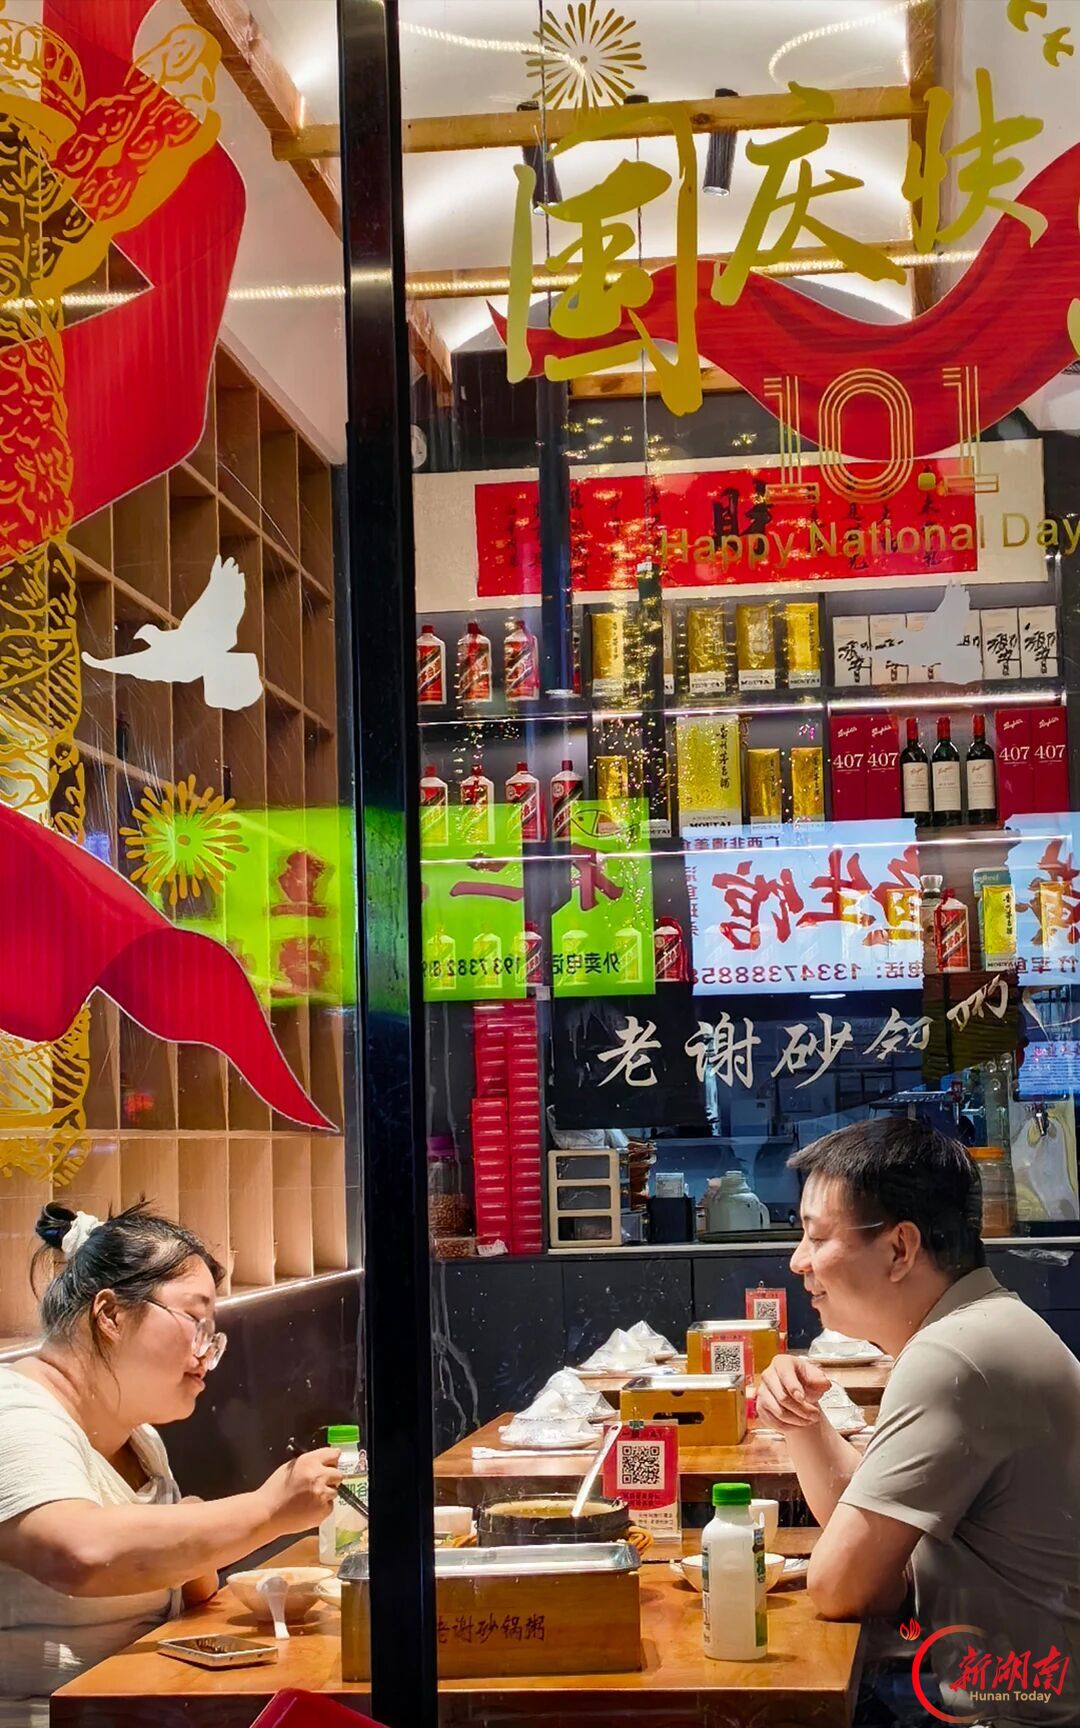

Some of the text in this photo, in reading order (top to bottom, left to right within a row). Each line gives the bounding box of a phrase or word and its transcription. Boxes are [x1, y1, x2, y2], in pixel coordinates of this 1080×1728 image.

[506, 68, 1080, 415] 国庆快
[661, 528, 795, 573] Happy
[809, 518, 986, 557] National
[1003, 512, 1080, 556] Day
[867, 752, 899, 767] 407
[1000, 746, 1030, 761] 407
[1034, 744, 1066, 760] 407
[833, 754, 864, 769] 407
